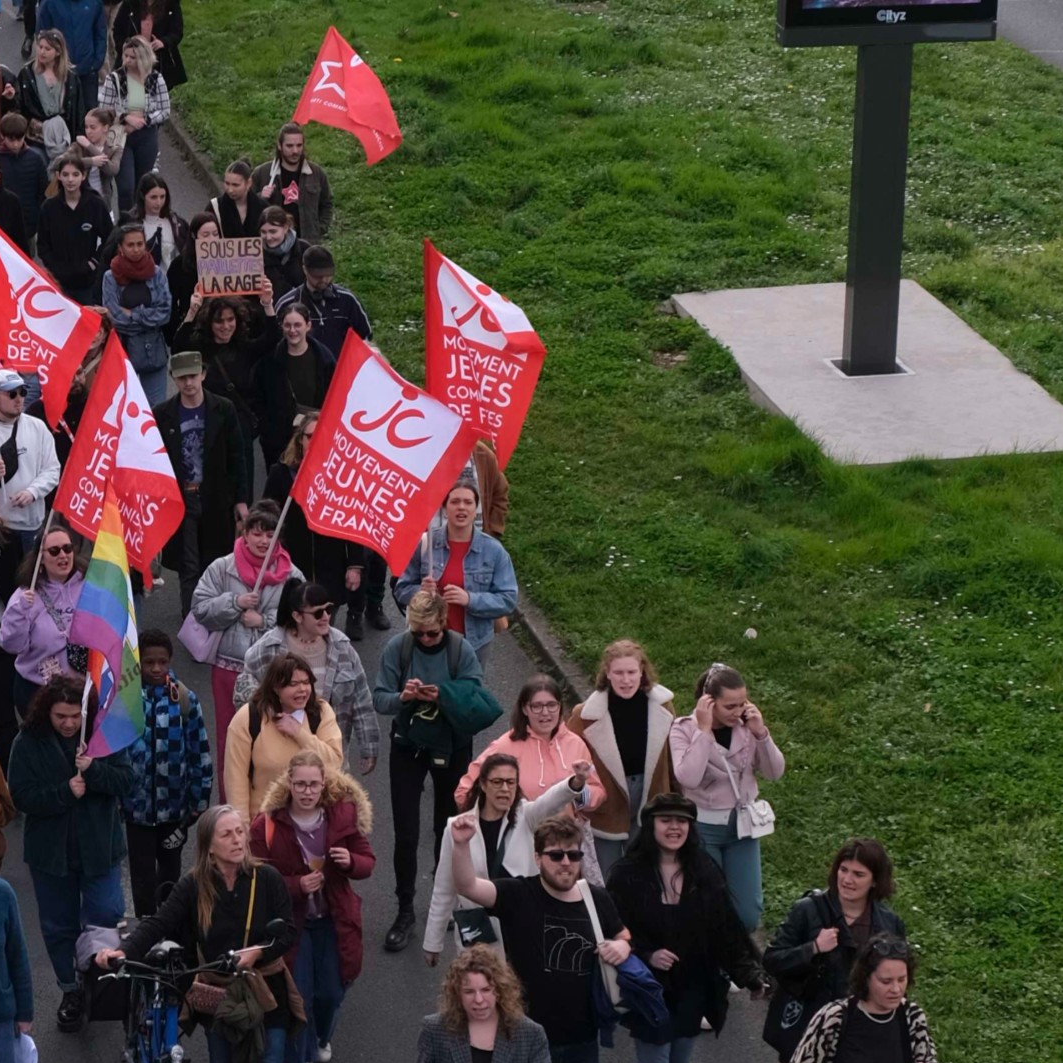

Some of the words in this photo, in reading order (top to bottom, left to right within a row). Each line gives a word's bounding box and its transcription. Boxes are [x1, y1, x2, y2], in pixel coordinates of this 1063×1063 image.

[200, 240, 234, 259] SOUS
[238, 239, 261, 257] LES
[202, 277, 221, 294] LA
[224, 274, 261, 293] RAGE
[323, 447, 408, 523] JEUNES
[333, 430, 421, 499] MOUVEMENT
[70, 492, 90, 518] DE
[307, 486, 319, 512] DE
[319, 506, 391, 551] FRANCE
[314, 473, 395, 540] COMMUNISTES
